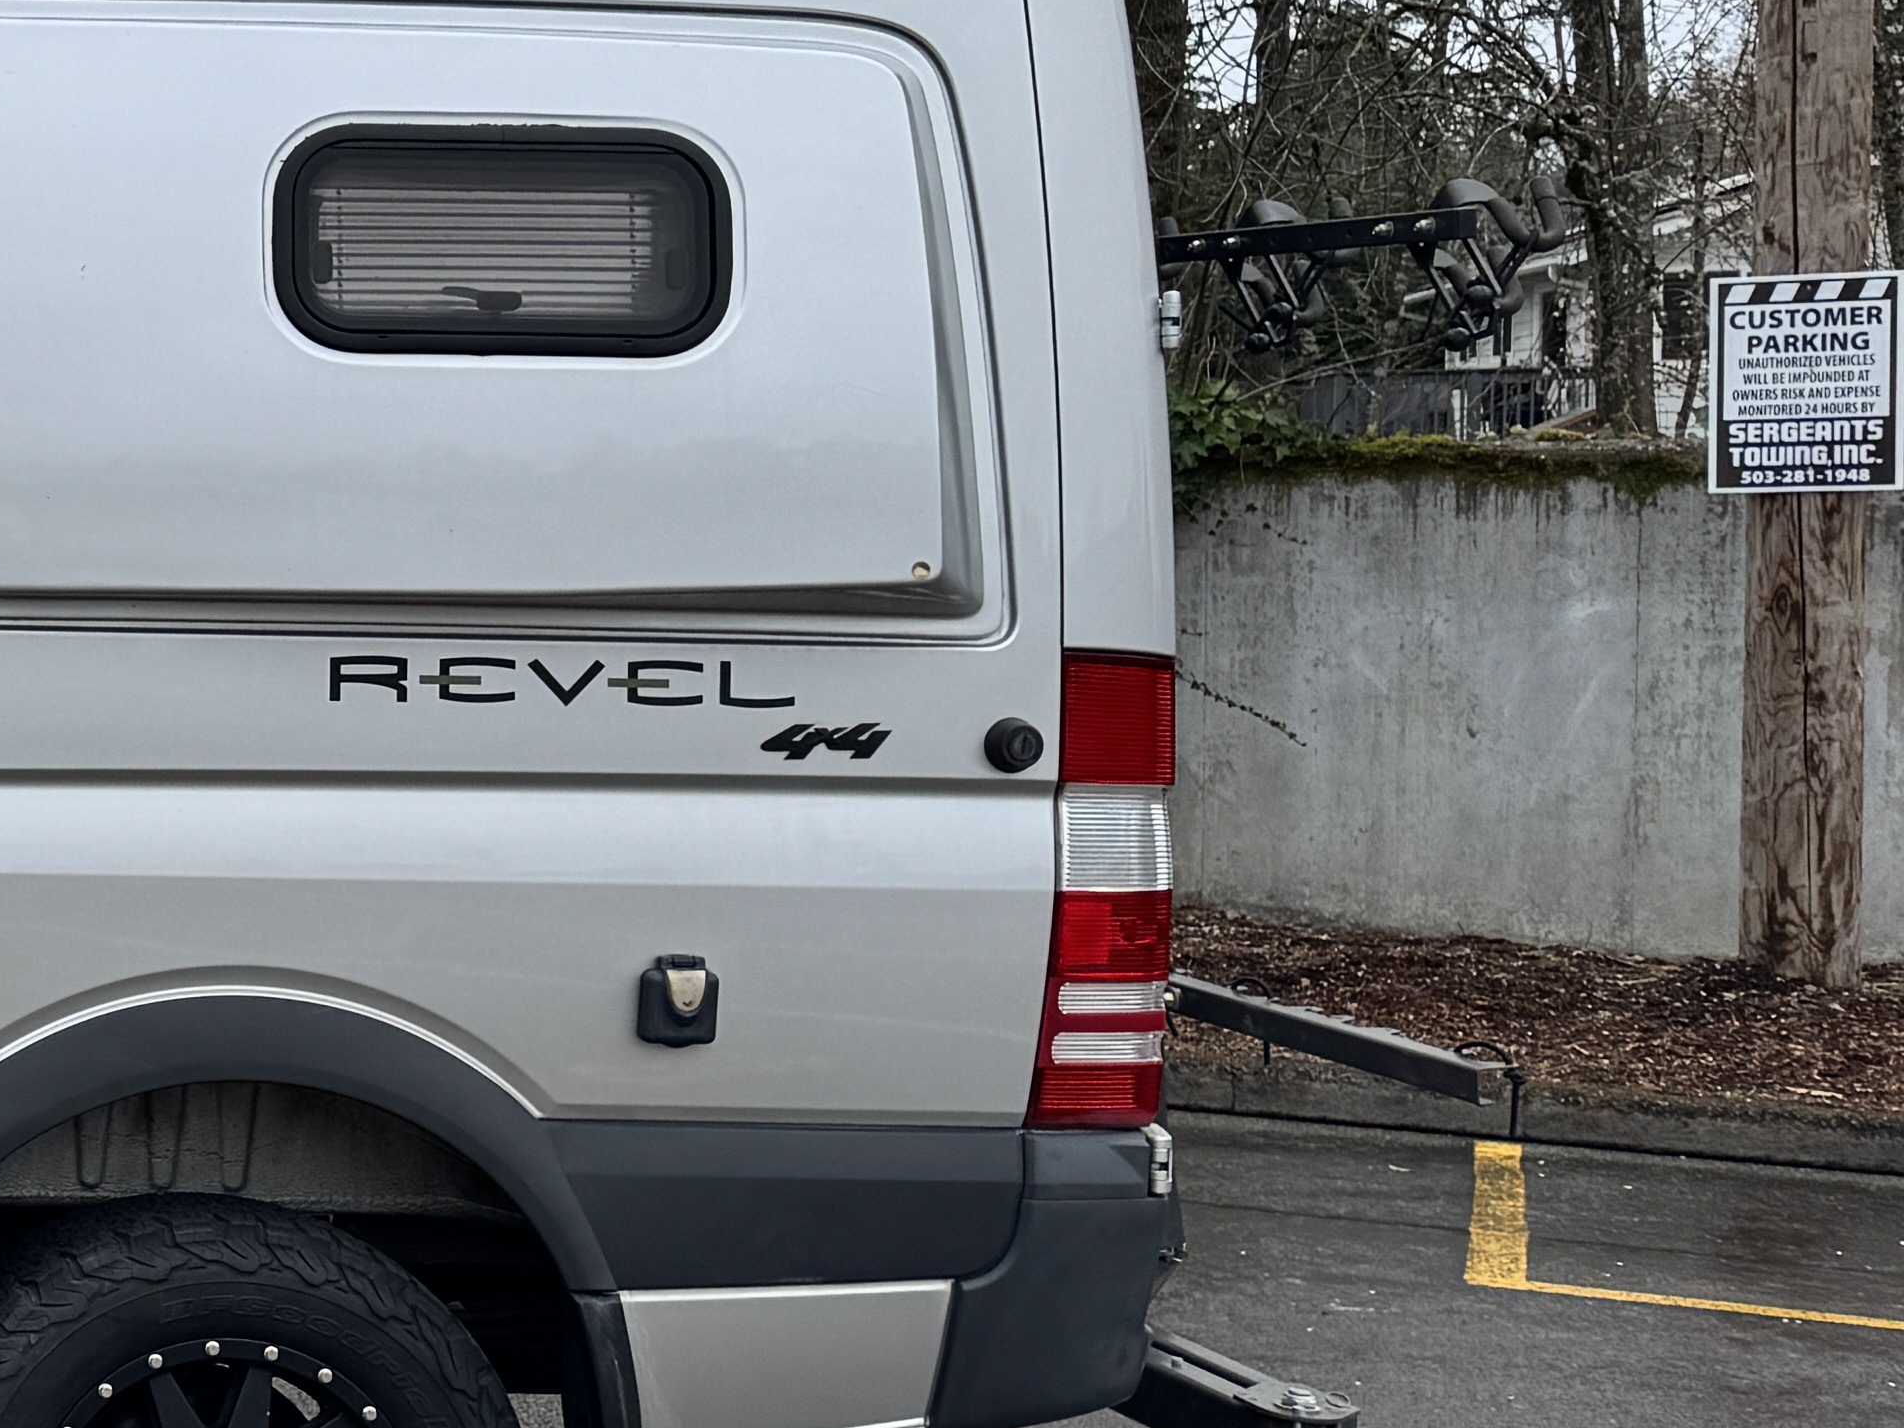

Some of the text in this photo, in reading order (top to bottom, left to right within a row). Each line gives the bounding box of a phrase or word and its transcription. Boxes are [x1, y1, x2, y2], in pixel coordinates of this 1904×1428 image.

[1729, 305, 1883, 330] CUSTOMER
[1747, 331, 1870, 354] PARKING
[1738, 353, 1876, 370] UNAUTHORIZED VEHICLES
[1743, 370, 1870, 385] WILL BE IMPOUNDED AT
[1732, 385, 1881, 401] OWNERS RISK AND EXPENSE
[1738, 401, 1876, 417] MONITORED 24 HOURS BY
[1728, 420, 1884, 444] SERGEANTS
[1740, 468, 1871, 484] 503-281-1948
[329, 655, 796, 707] REVEL
